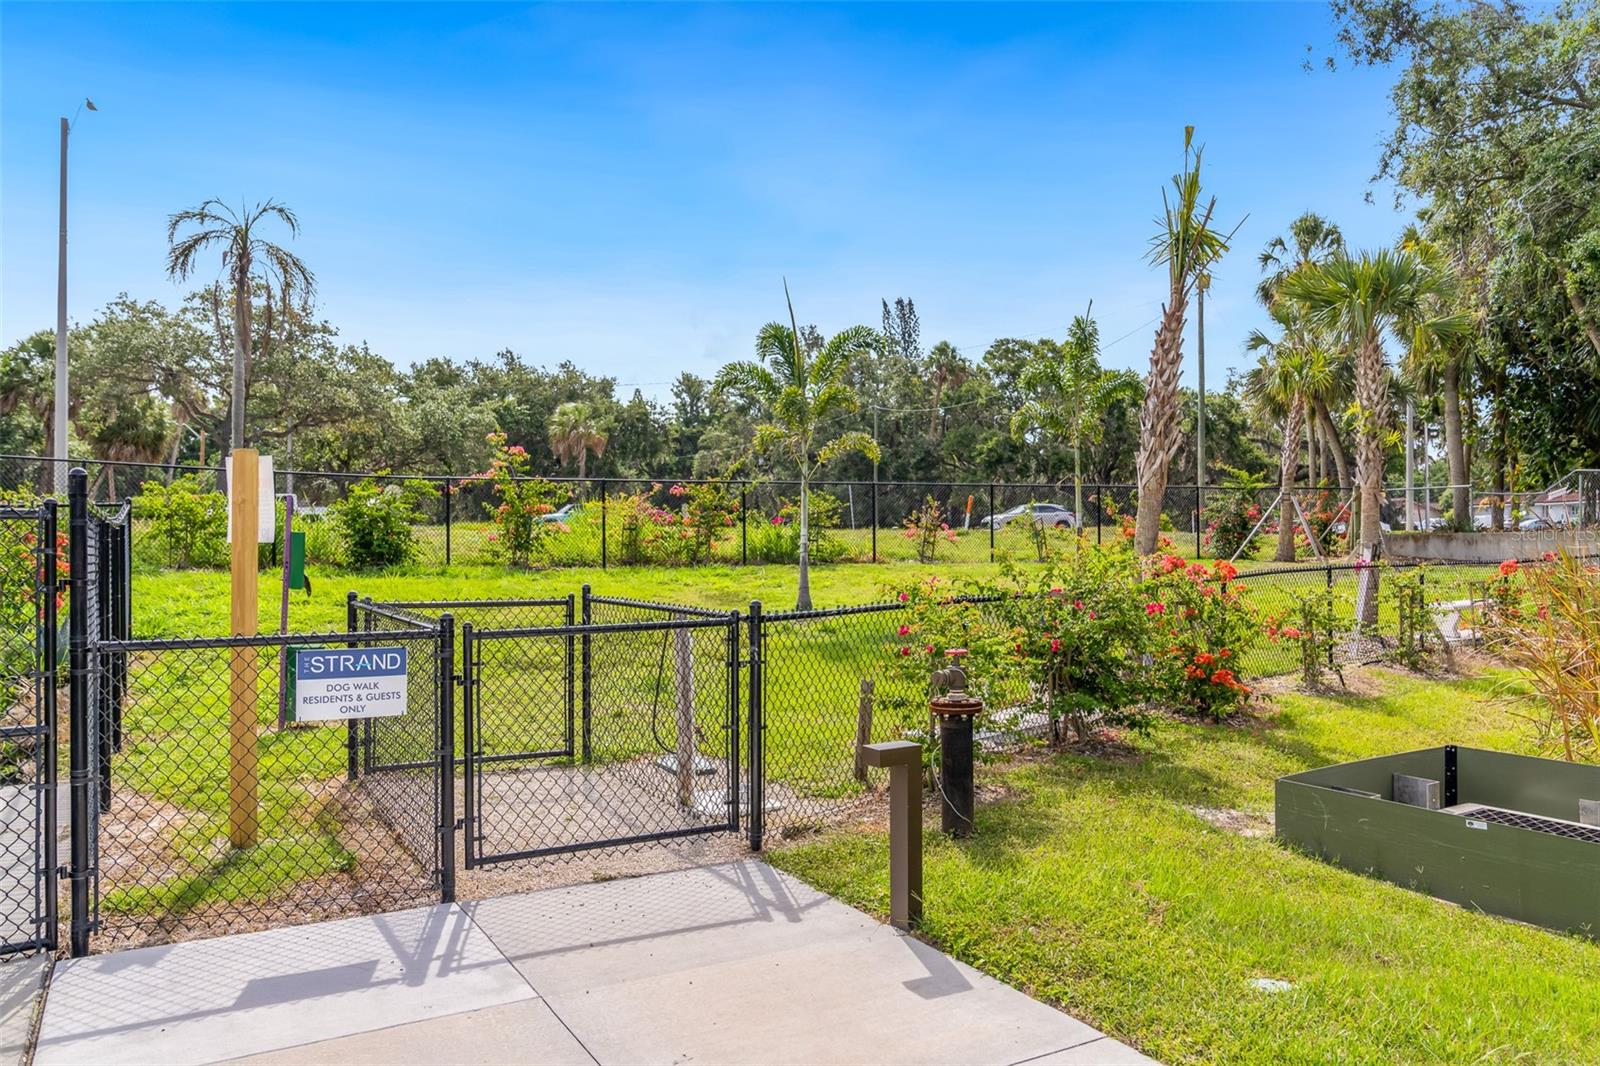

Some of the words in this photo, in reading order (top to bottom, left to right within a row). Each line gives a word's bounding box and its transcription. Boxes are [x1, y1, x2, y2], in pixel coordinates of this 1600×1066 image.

[310, 653, 401, 673] STRAND
[326, 683, 351, 693] DOG
[353, 682, 380, 691] WALK
[302, 693, 354, 705] RESIDENTS
[356, 693, 363, 702] &
[366, 691, 401, 701] GUESTS
[339, 704, 366, 714] ONLY
